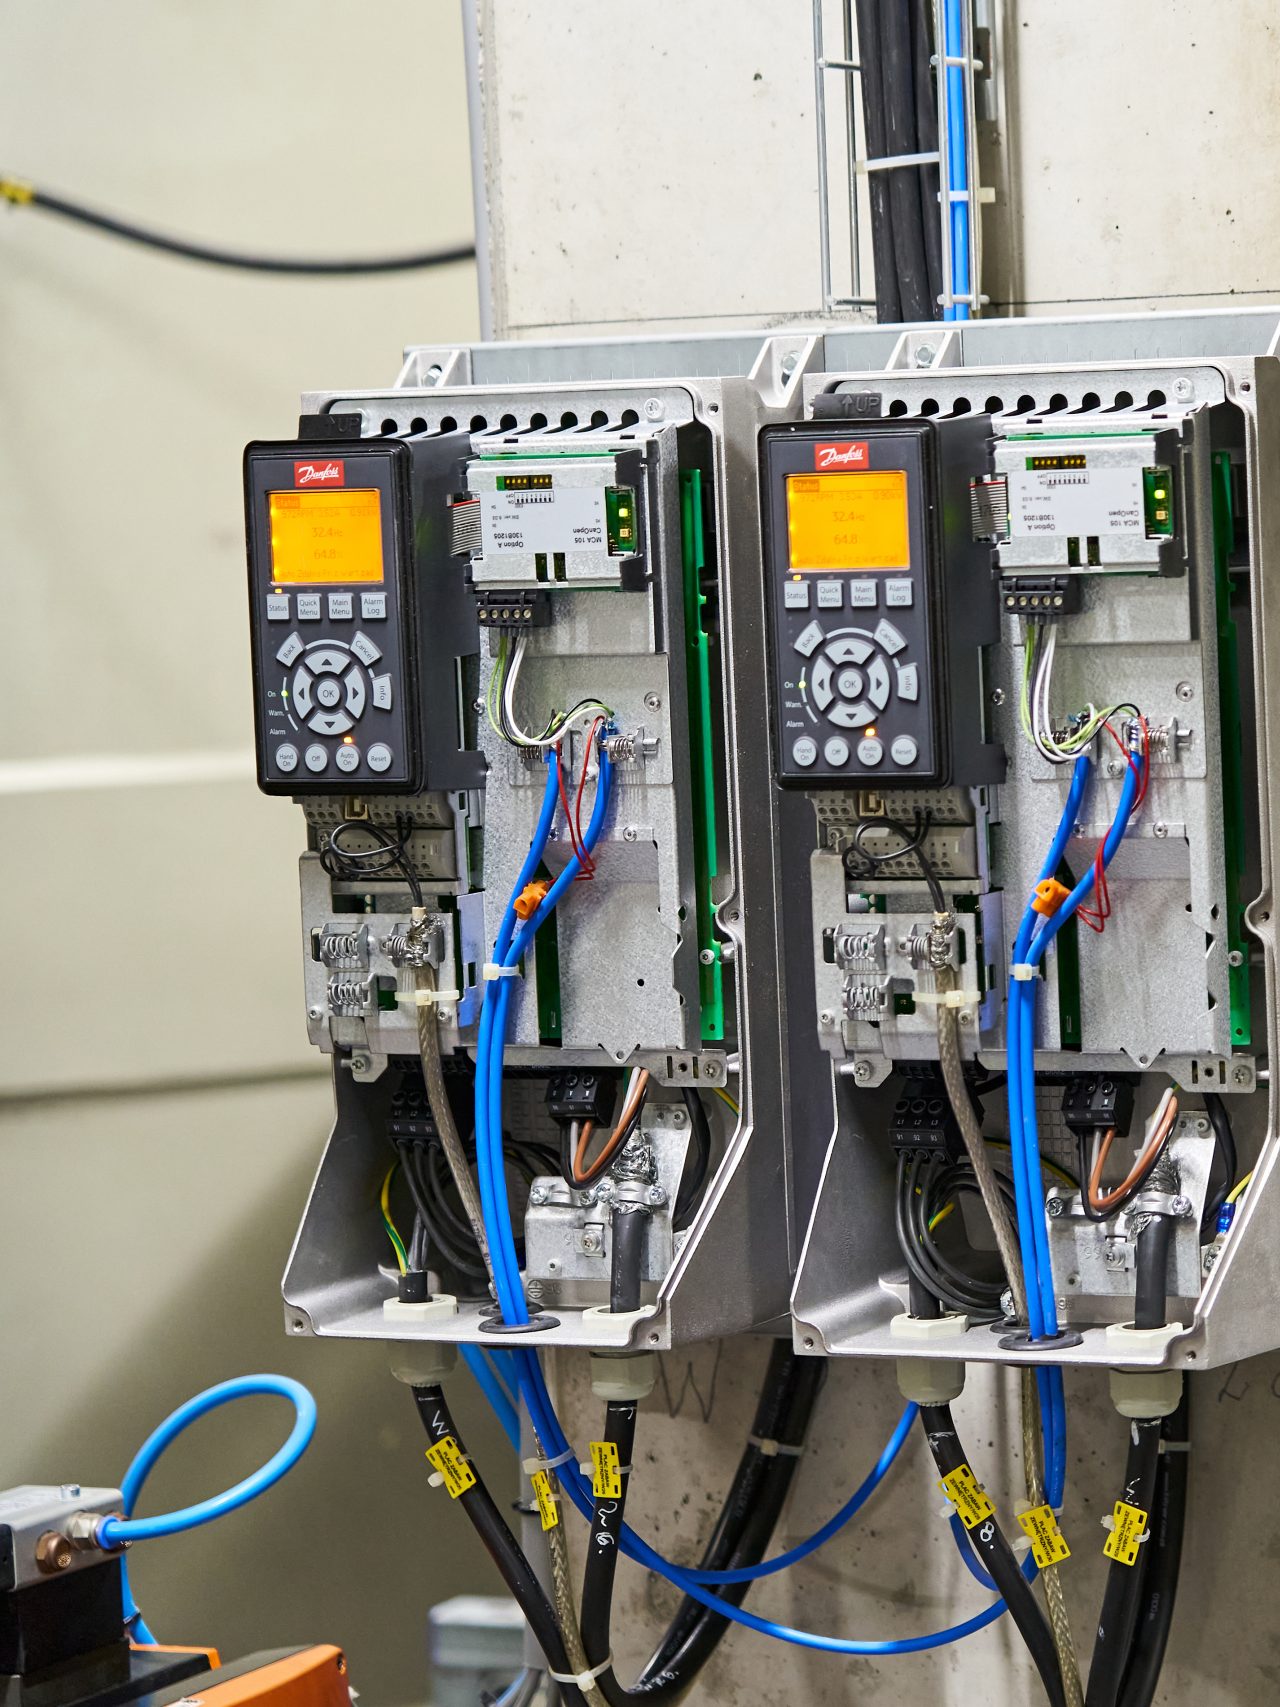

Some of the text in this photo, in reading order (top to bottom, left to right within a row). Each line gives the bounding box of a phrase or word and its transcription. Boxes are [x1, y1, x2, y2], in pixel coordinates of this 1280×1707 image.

[855, 396, 880, 412] UP
[819, 444, 864, 467] Danfoss
[298, 463, 340, 484] Danfoss
[820, 586, 839, 594] Quick
[889, 584, 910, 592] Alarm
[786, 592, 807, 600] Status
[854, 595, 874, 603] Menu
[892, 594, 906, 602] Log
[299, 599, 318, 607] Quick
[332, 598, 349, 606] Main
[268, 604, 288, 612] Status
[367, 607, 380, 616] Log
[282, 644, 296, 659] Back
[355, 640, 375, 661] Cancel
[843, 679, 857, 689] OK
[322, 689, 335, 698] OK
[786, 720, 805, 728] Alarm
[958, 1480, 982, 1511] PLAC ZABAW
[1125, 1519, 1134, 1533] PLAC
[1037, 1520, 1057, 1554] PLAC ZABAW
